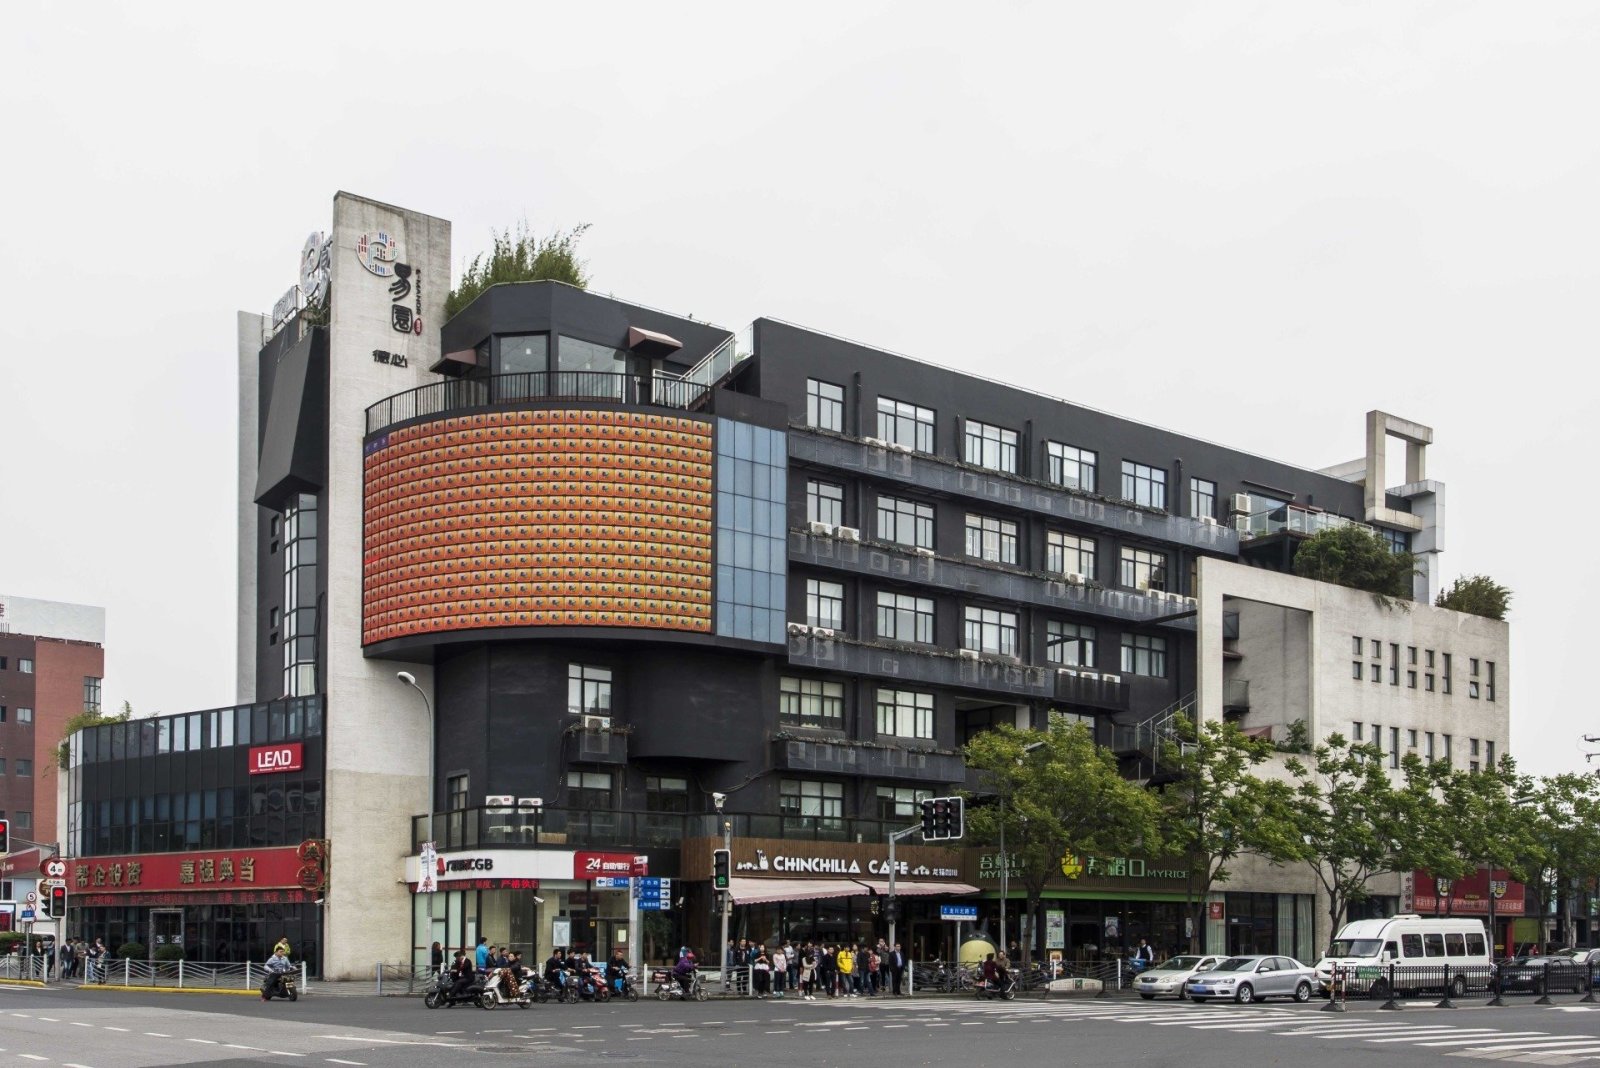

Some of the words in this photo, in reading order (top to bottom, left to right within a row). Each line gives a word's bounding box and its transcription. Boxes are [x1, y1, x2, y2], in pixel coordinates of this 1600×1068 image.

[257, 750, 292, 768] LEAD
[50, 865, 57, 873] 4
[586, 858, 601, 870] 24
[773, 856, 861, 873] CHINCHILLA
[1147, 868, 1190, 879] MYRICE
